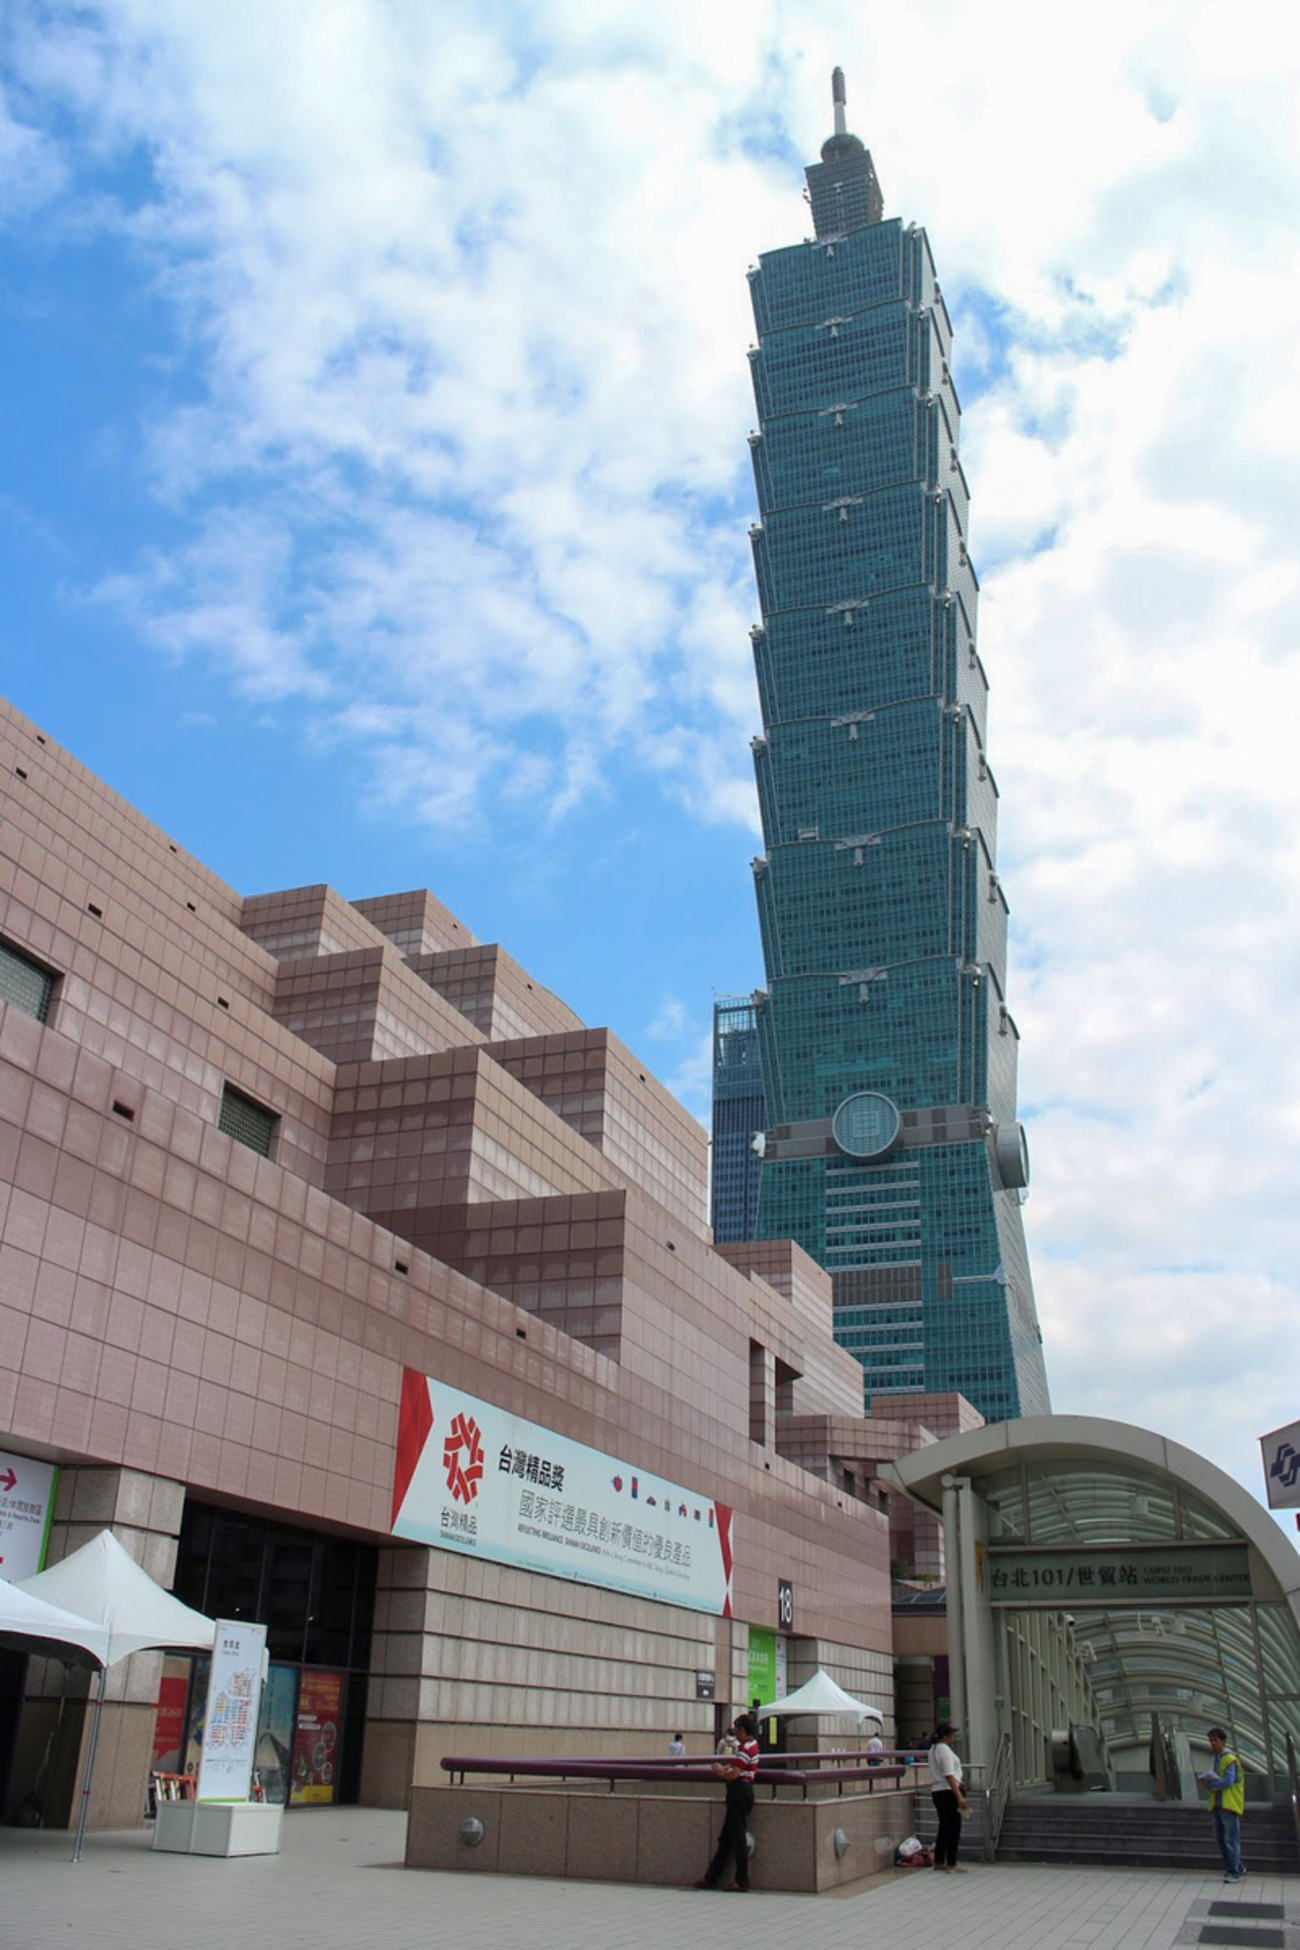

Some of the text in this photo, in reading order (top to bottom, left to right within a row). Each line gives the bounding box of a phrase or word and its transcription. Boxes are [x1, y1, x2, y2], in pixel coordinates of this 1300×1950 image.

[499, 1444, 565, 1492] 台灣精品獎
[991, 1565, 1138, 1588] 台北101/世貿站
[1143, 1576, 1179, 1585] WORLD
[1213, 1574, 1250, 1583] CENTER
[778, 1587, 793, 1624] 18
